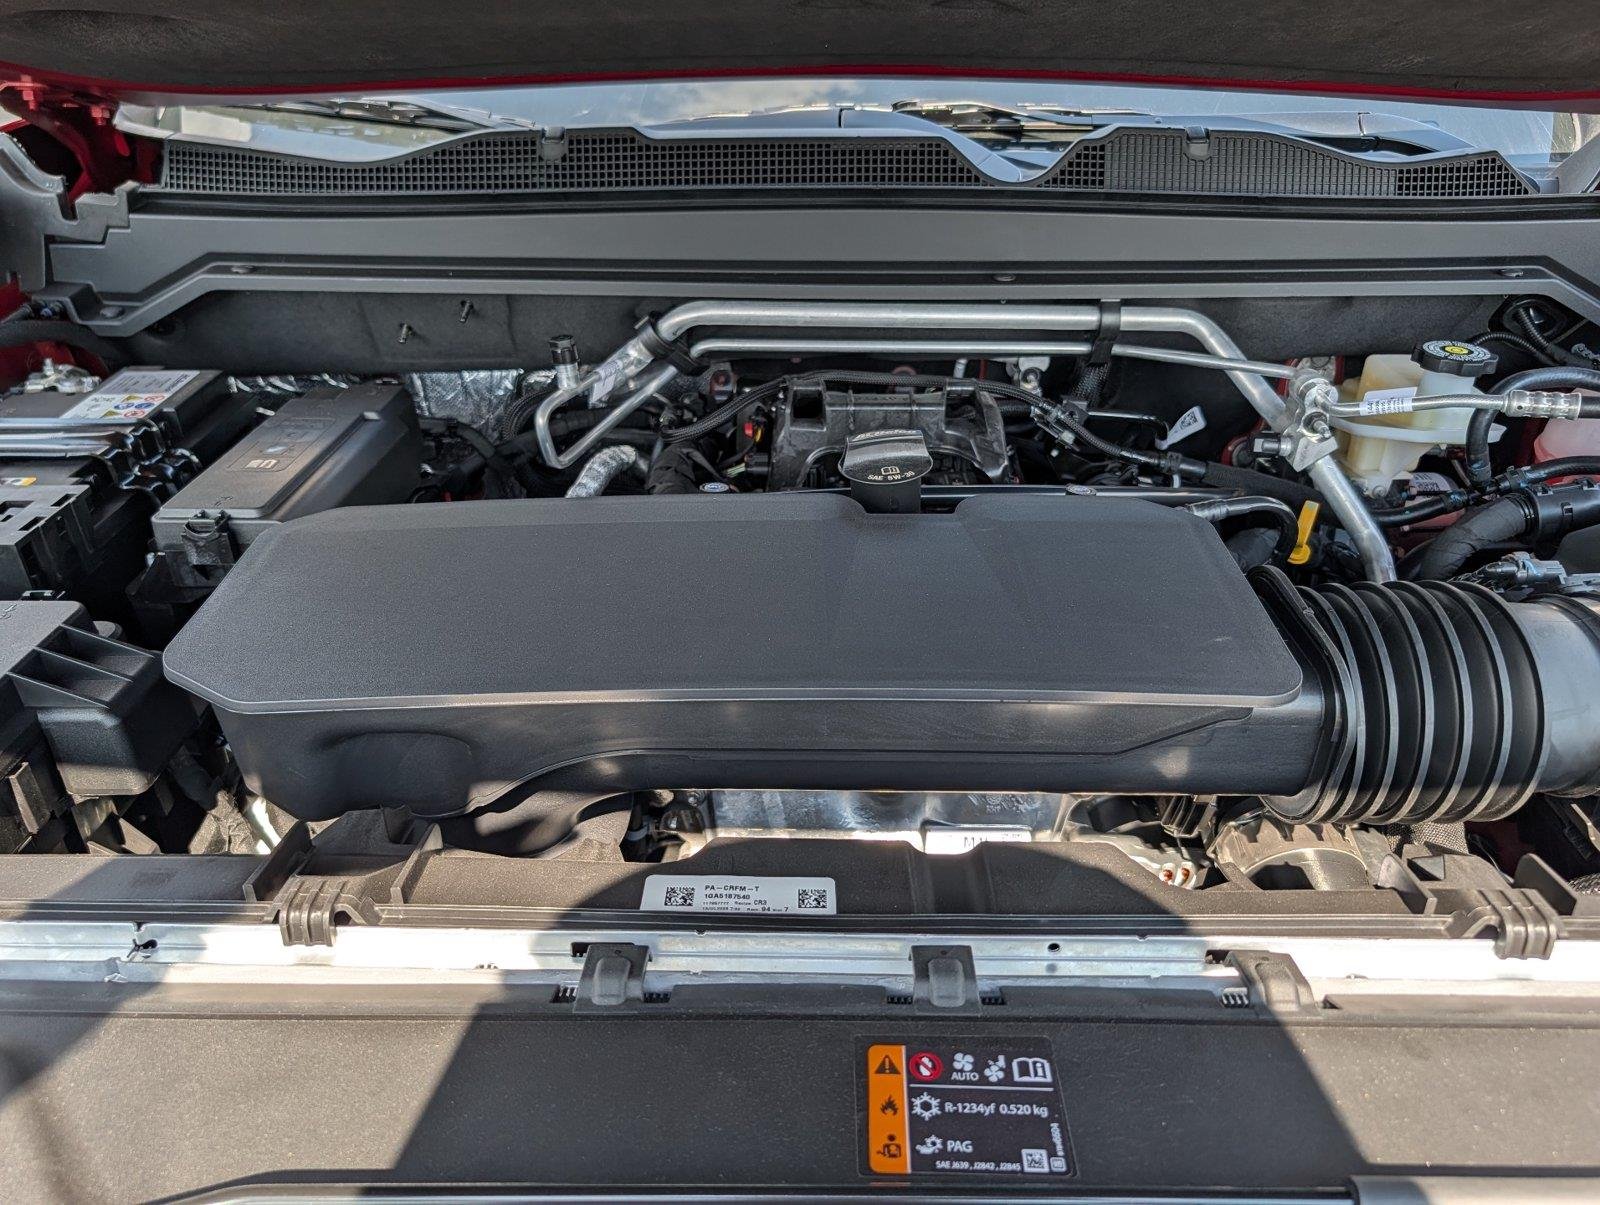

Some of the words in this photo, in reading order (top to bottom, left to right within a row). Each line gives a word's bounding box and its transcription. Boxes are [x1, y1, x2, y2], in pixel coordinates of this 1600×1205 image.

[951, 1072, 979, 1081] AUTO
[944, 1102, 996, 1116] R-1234yf
[999, 1105, 1032, 1115] 0.520
[1033, 1105, 1049, 1118] kg
[947, 1140, 973, 1153] PAG
[935, 1160, 951, 1169] SAE
